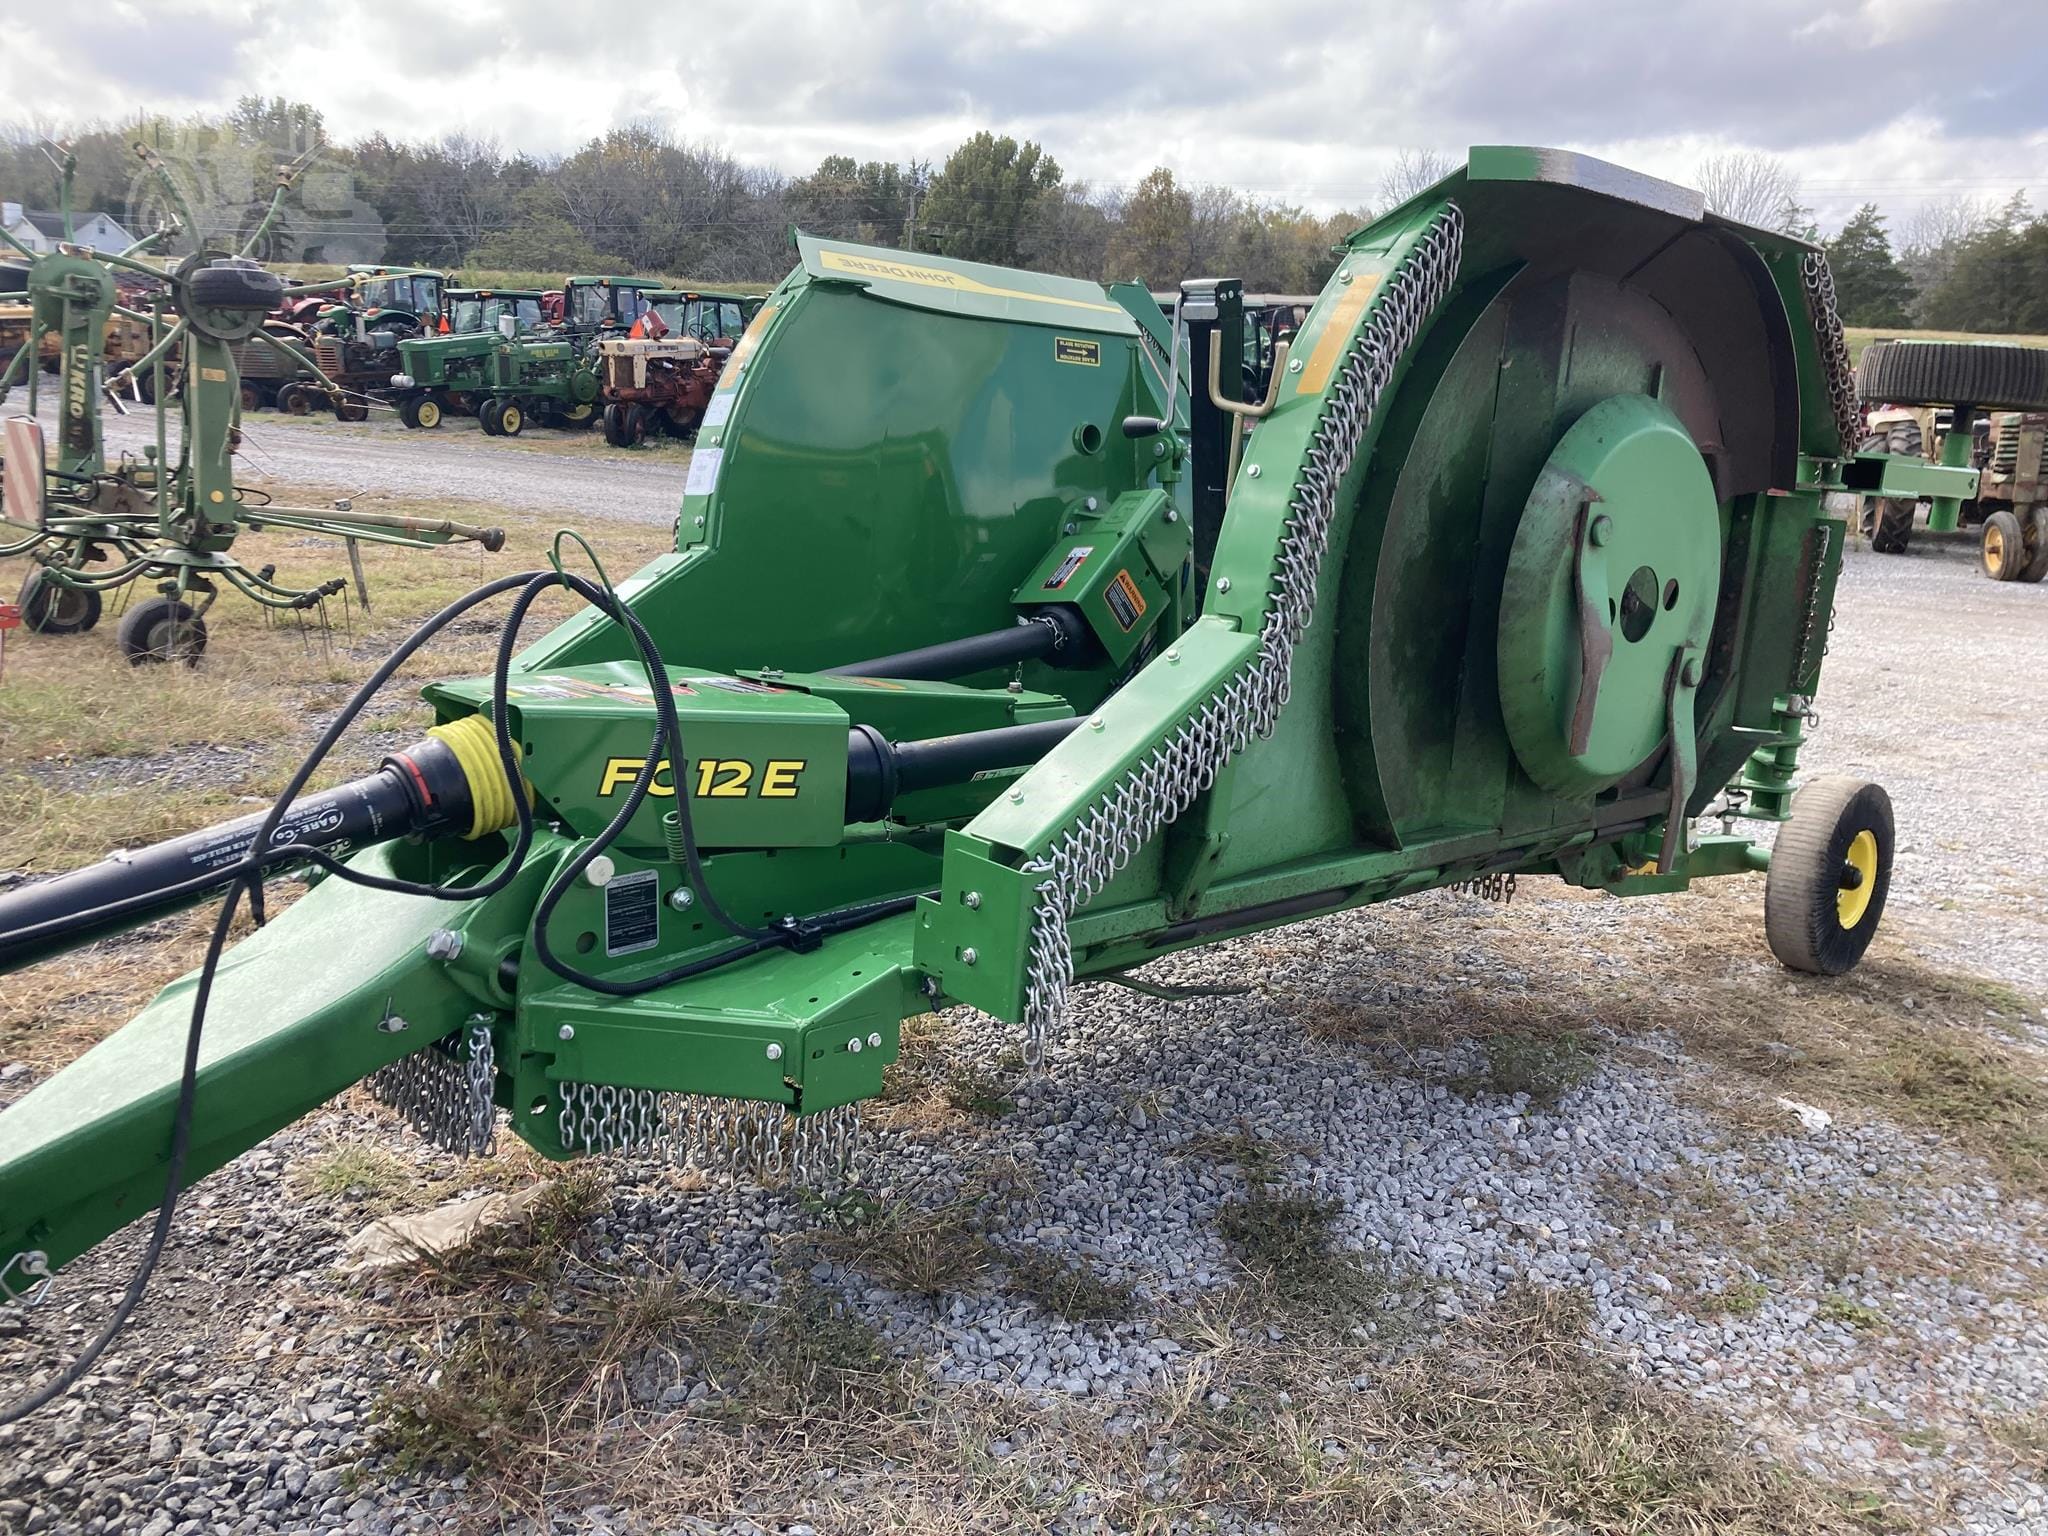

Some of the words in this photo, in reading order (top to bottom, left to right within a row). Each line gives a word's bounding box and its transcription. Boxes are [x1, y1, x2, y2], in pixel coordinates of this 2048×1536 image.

[838, 258, 906, 277] DEERE
[906, 270, 955, 285] JOHN
[1123, 579, 1144, 613] WARNING
[597, 756, 688, 798] FC
[694, 758, 754, 799] 12
[758, 758, 808, 799] E
[275, 814, 338, 840] BARE-Co
